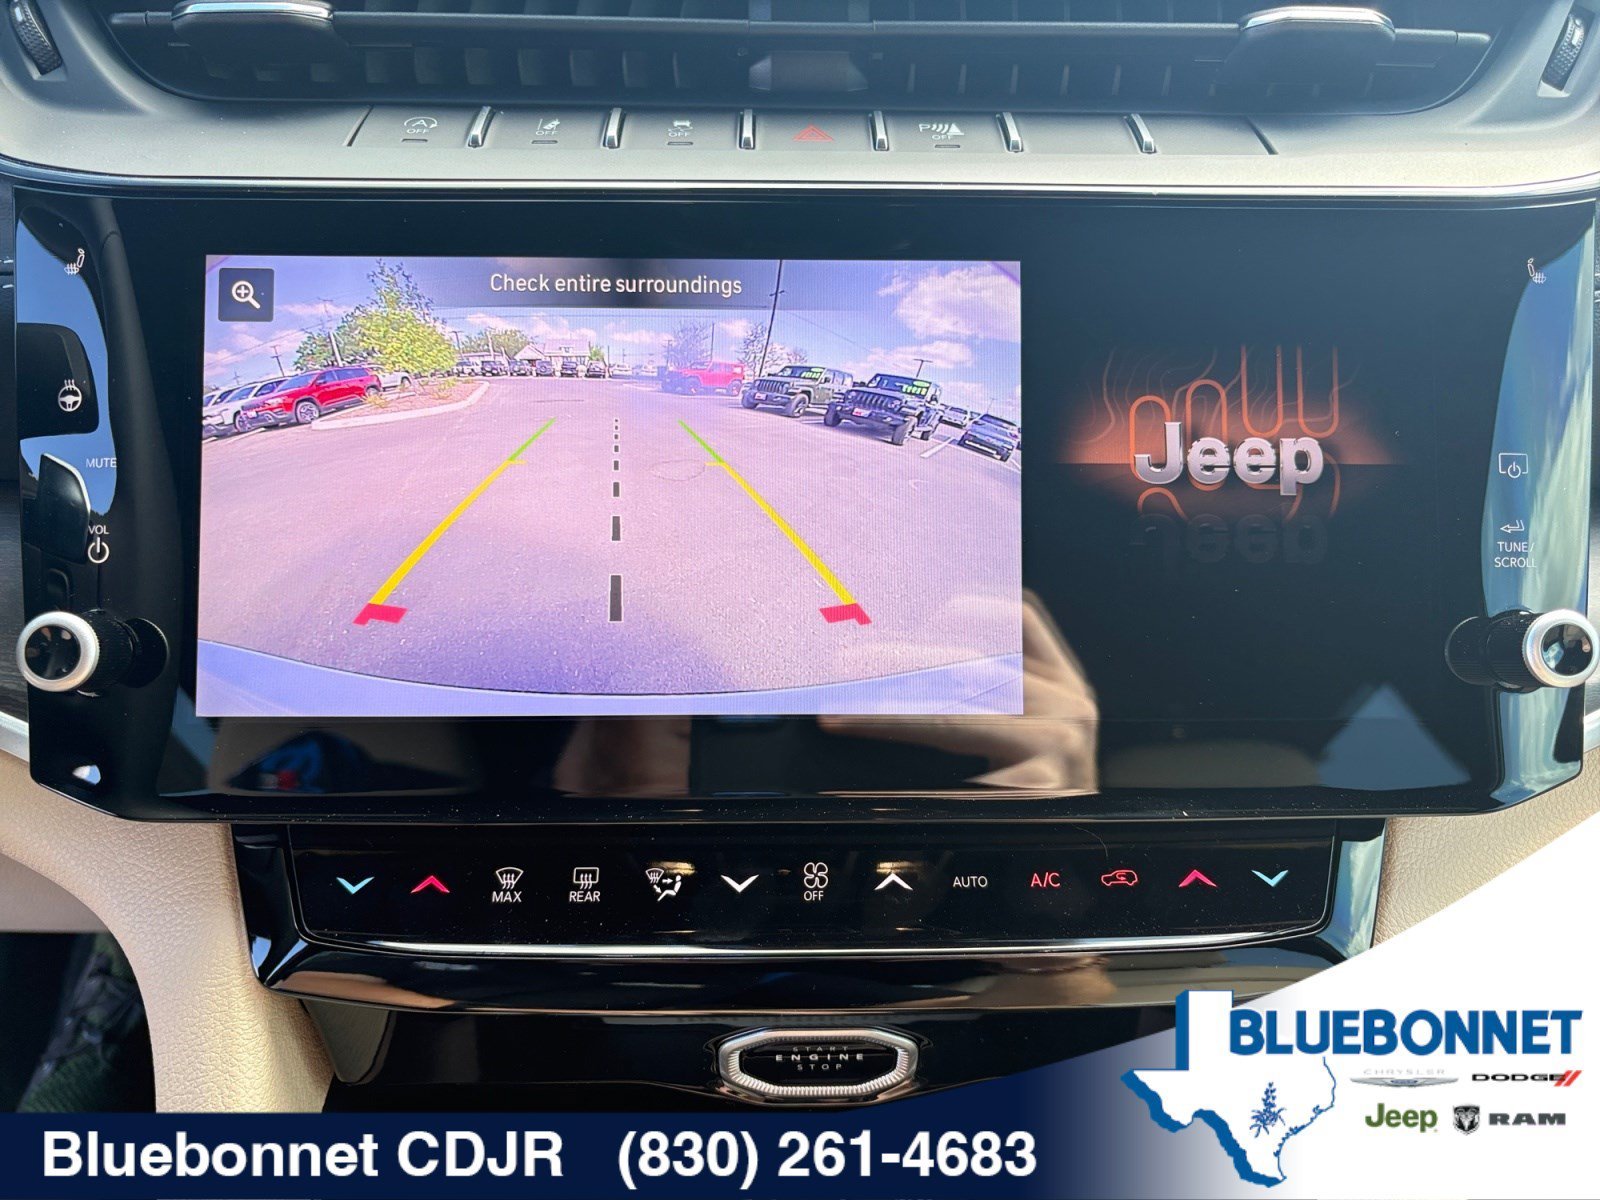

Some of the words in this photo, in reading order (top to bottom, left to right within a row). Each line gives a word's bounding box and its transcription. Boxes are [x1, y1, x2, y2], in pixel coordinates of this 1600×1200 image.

[490, 273, 550, 292] Check
[554, 275, 611, 292] entire
[615, 275, 742, 298] surroundings
[85, 457, 118, 469] MUTE
[1134, 421, 1324, 496] Jeep
[88, 525, 110, 535] VOL
[1496, 541, 1535, 553] TUNE/
[1494, 556, 1537, 568] SCROLL
[952, 875, 988, 888] AUTO
[1030, 871, 1061, 888] A/C
[491, 890, 522, 903] MAX
[569, 890, 601, 902] REAR
[803, 890, 824, 901] OFF
[775, 1053, 864, 1062] ENGINE
[797, 1063, 842, 1071] STOP
